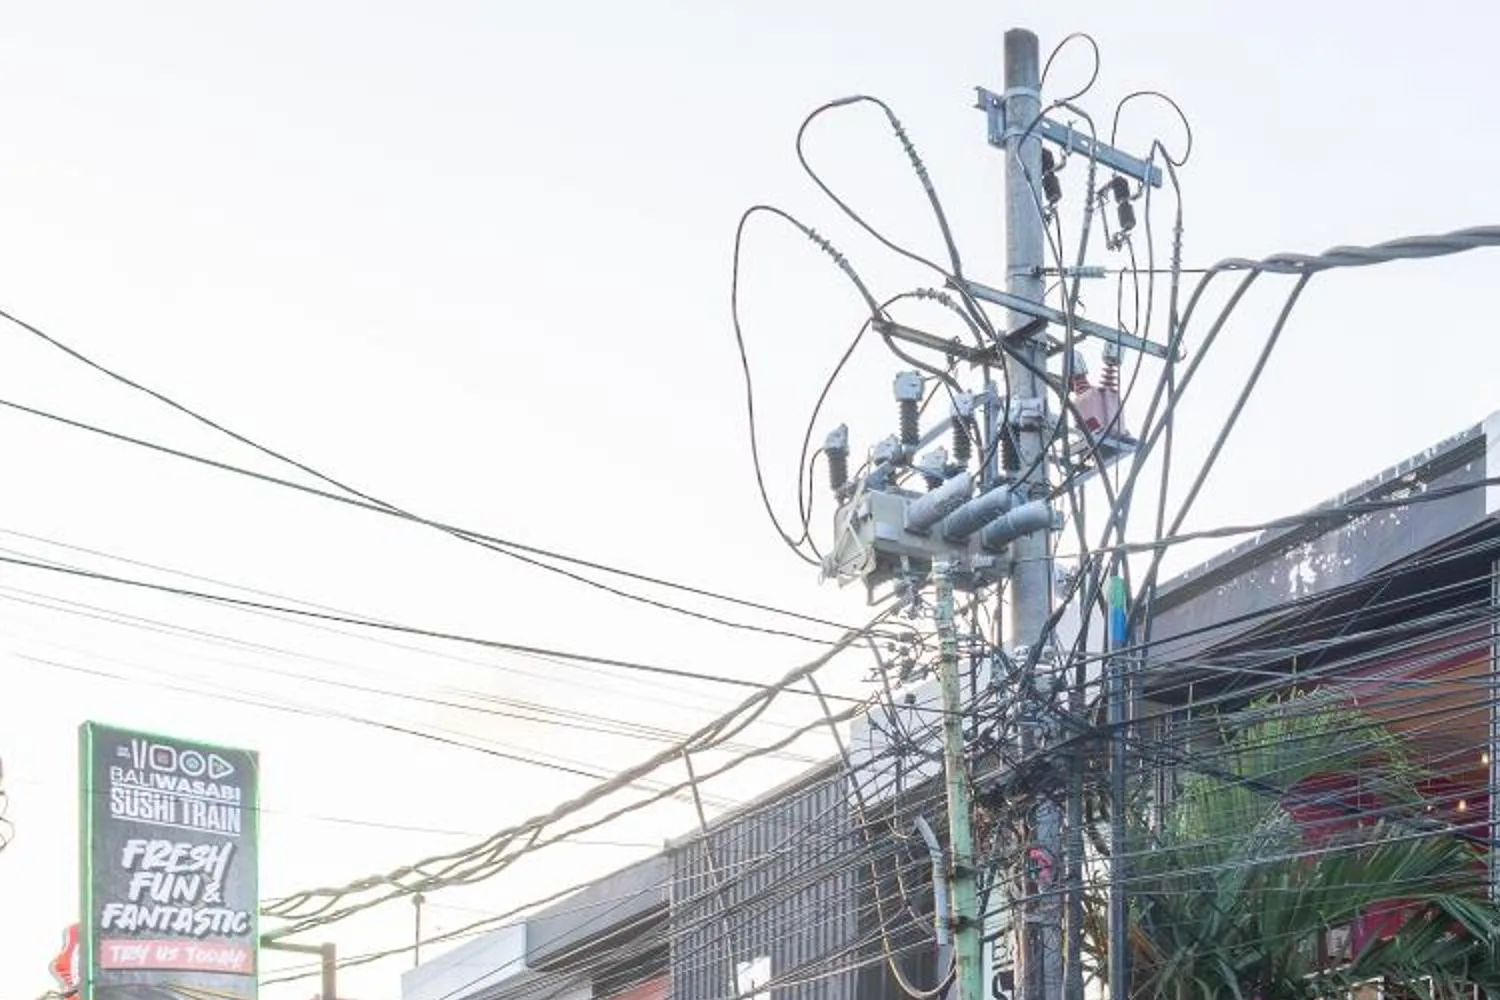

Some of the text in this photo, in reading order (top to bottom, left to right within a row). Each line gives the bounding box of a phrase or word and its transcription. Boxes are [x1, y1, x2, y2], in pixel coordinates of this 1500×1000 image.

[111, 787, 241, 833] SUSHI TRAIN
[121, 839, 233, 884] FRESH
[128, 871, 222, 903] FUN &
[101, 903, 248, 936] FANTASTIC
